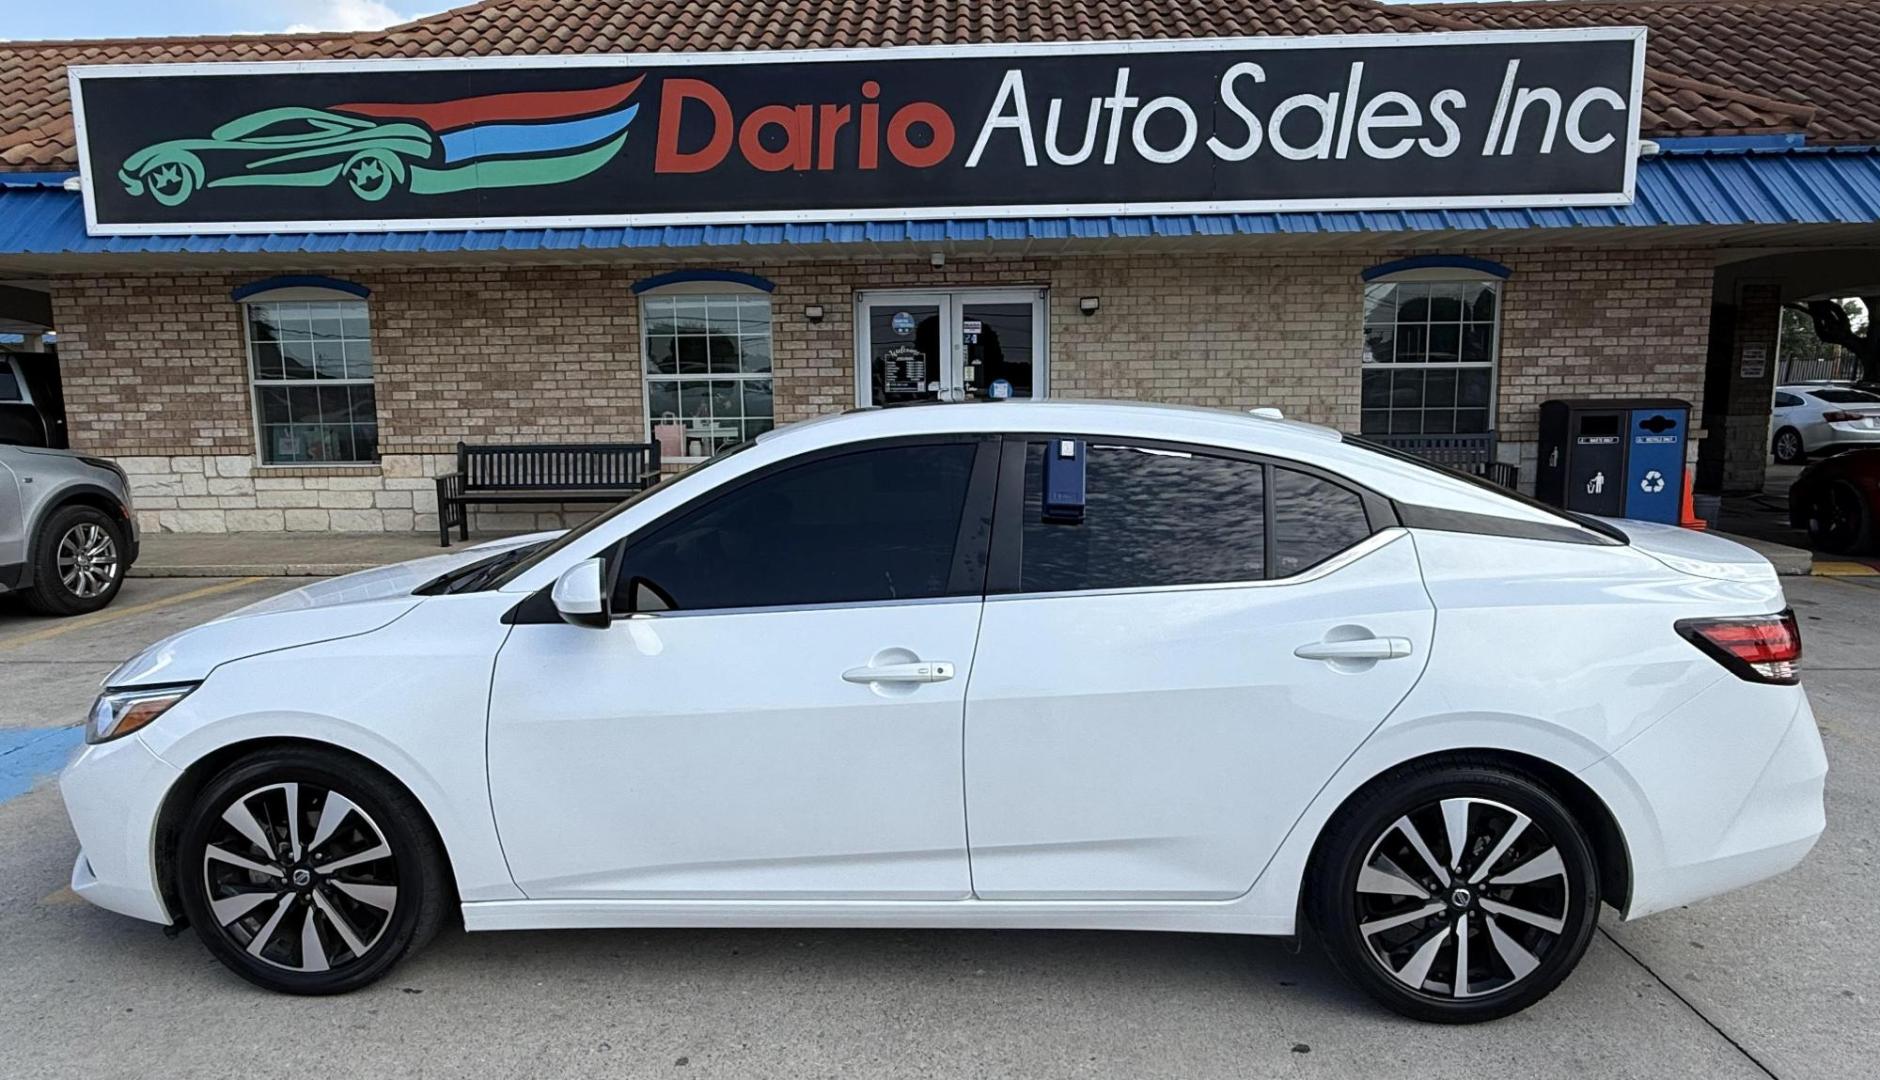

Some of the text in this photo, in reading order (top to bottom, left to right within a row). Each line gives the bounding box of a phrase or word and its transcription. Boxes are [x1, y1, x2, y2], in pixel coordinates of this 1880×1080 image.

[654, 58, 1627, 173] Dario Auto Sales Inc
